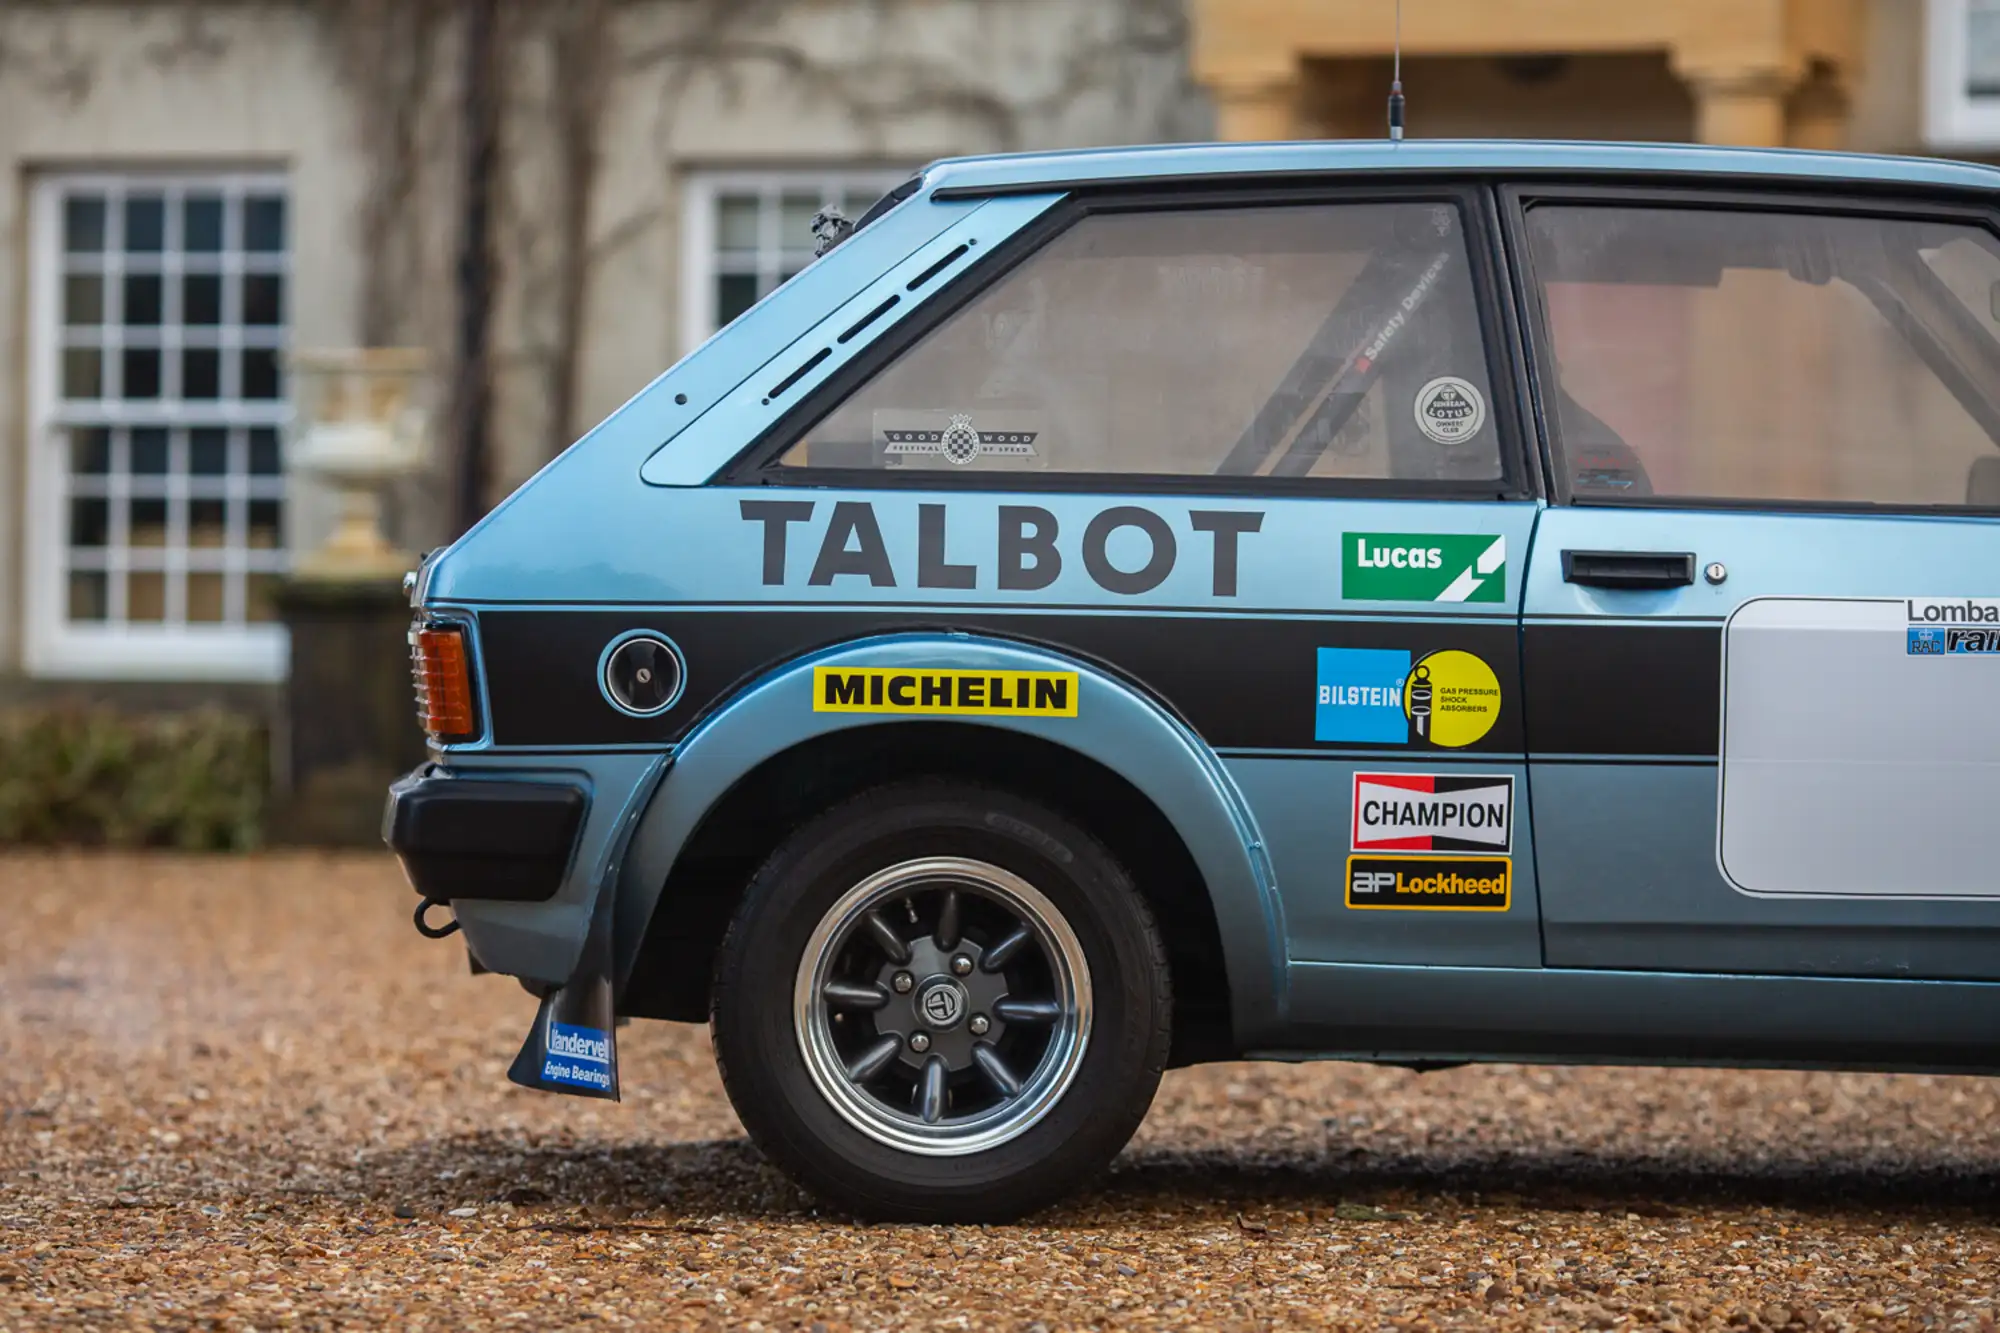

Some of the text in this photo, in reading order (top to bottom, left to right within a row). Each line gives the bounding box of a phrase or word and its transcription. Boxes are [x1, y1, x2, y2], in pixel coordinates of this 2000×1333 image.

[1364, 251, 1450, 362] Safety Devices
[1428, 407, 1472, 418] LOTUS
[739, 500, 1266, 597] TALBOT
[1357, 538, 1442, 568] Lucas
[1911, 639, 1941, 653] RAC
[824, 674, 1068, 709] MICHELIN
[1319, 684, 1401, 707] BILSTEIN
[1458, 688, 1498, 696] PRESSURE
[1440, 705, 1488, 713] ABSORBERS
[1363, 800, 1504, 828] CHAMPION
[1396, 872, 1505, 894] Lockheed
[544, 1061, 610, 1088] Engine Bearings
